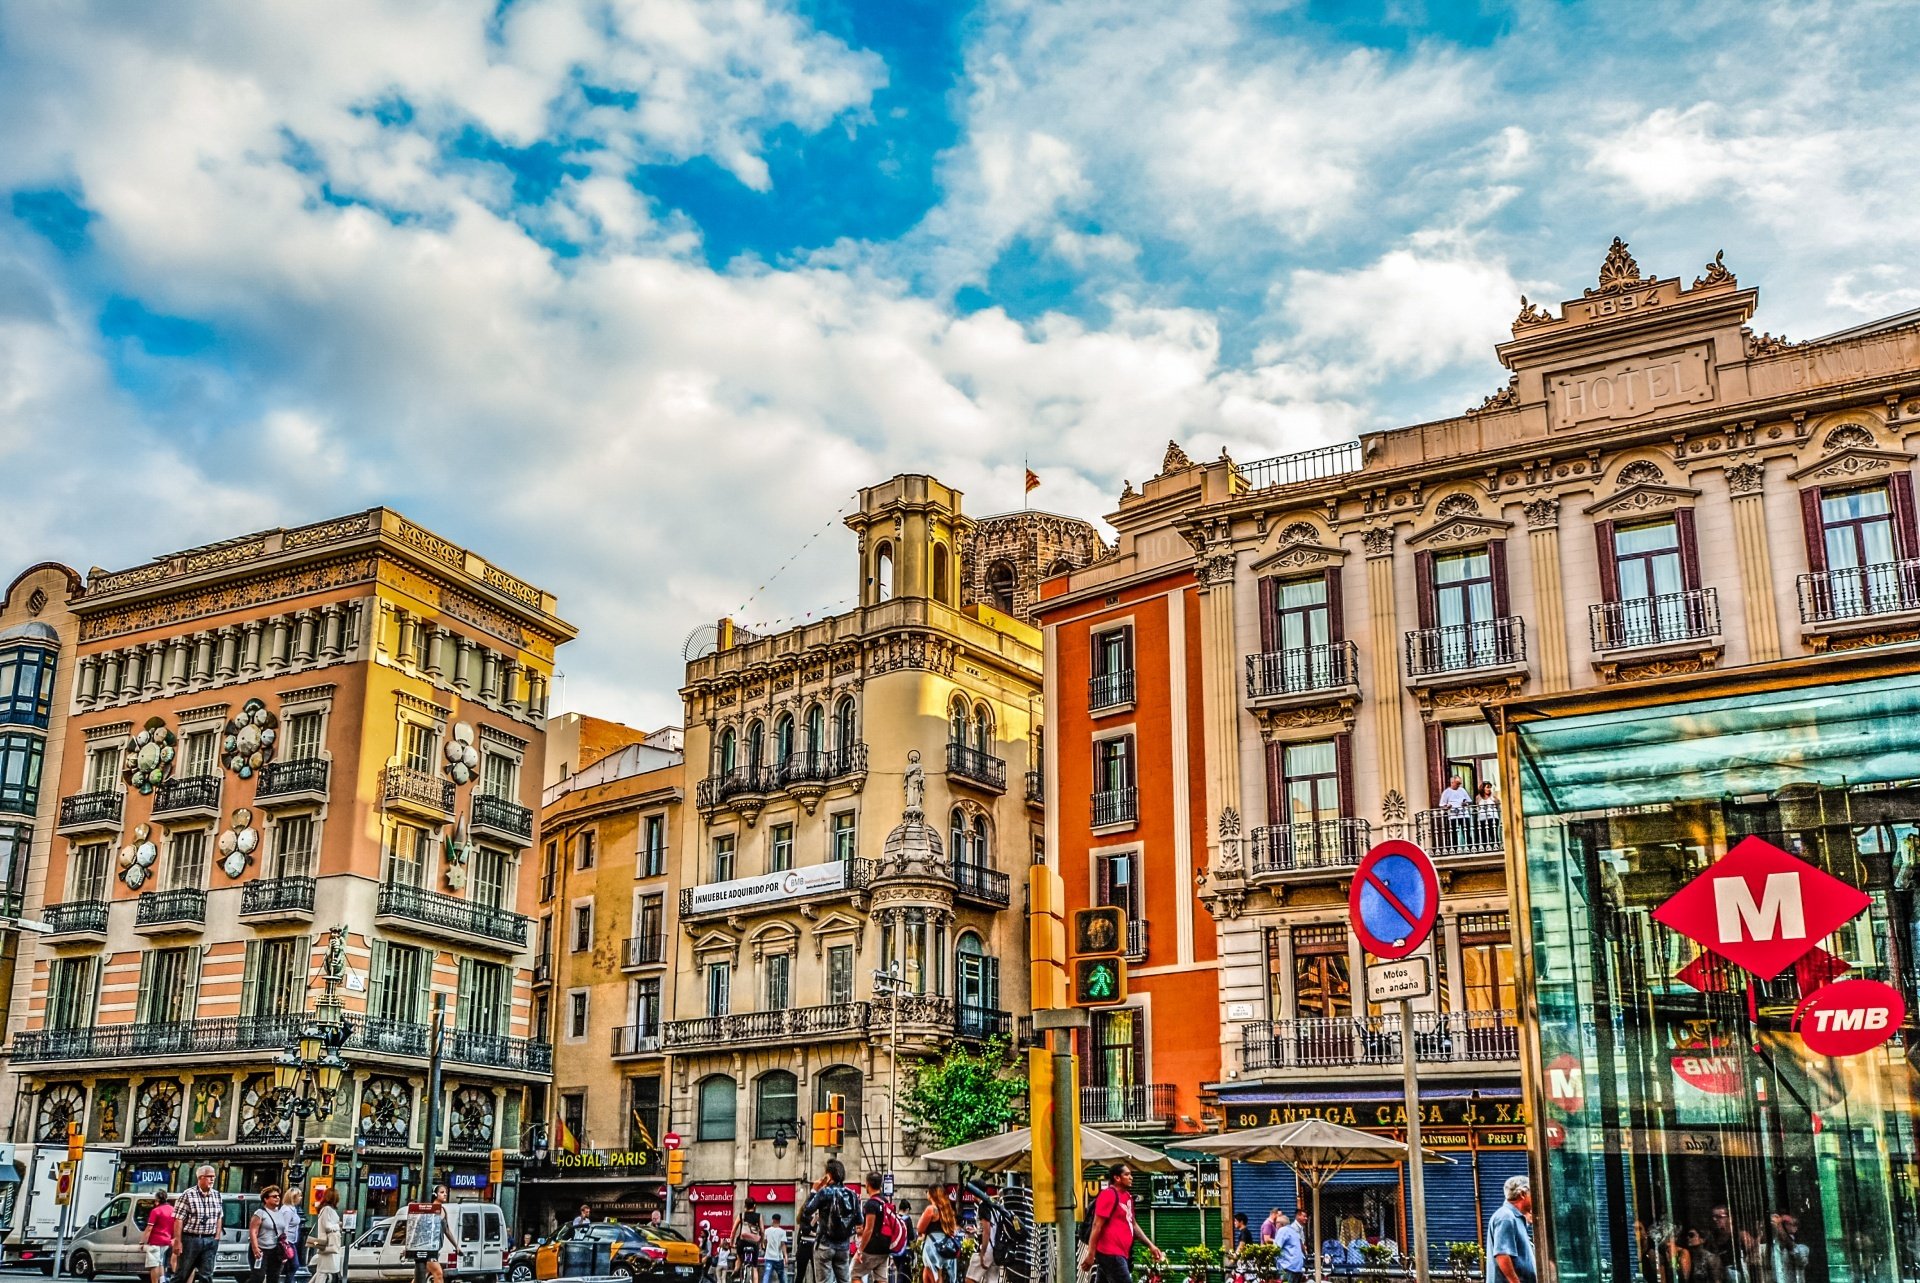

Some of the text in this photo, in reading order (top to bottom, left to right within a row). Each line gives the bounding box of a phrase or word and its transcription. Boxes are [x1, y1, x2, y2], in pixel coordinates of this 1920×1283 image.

[1585, 290, 1660, 319] 1894
[1563, 360, 1697, 417] HOTEL
[695, 882, 779, 904] INMUEBLE ADQUIRIDO POR
[1713, 871, 1807, 944] M
[1383, 970, 1408, 980] Motos
[1389, 981, 1419, 992] andana
[1813, 1007, 1889, 1032] TMB
[1239, 1114, 1258, 1126] 80
[1268, 1107, 1357, 1125] ANTIGA
[1376, 1104, 1444, 1124] CASA
[1428, 1134, 1467, 1144] INTERIOR
[1487, 1133, 1514, 1144] PREU
[557, 1151, 647, 1167] HOSTAL PARIS
[142, 1171, 163, 1182] BBVA
[368, 1175, 392, 1187] BBVA
[455, 1175, 476, 1186] BBVA
[700, 1190, 734, 1201] Santander
